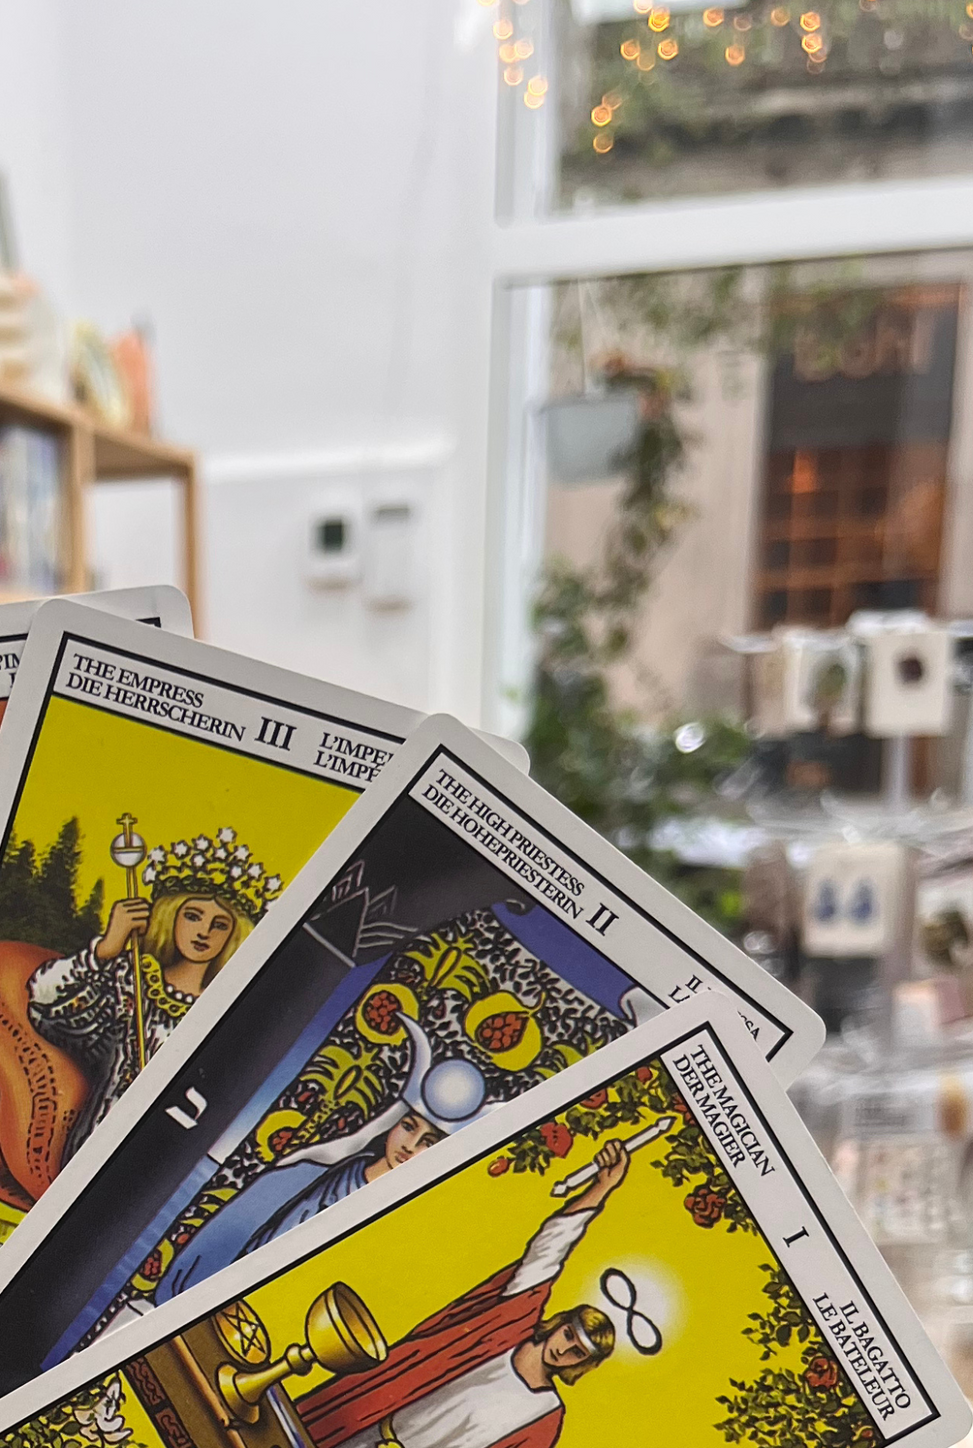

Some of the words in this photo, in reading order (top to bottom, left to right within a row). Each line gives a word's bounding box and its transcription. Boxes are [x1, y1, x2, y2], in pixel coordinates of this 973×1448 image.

[65, 672, 103, 697] DIE
[103, 684, 246, 742] HERRSCHERIN
[73, 653, 116, 681] THE
[118, 668, 205, 709] EMPRESS
[254, 716, 297, 752] III
[422, 784, 455, 815] DIE
[449, 806, 584, 920] HOHEPRIESTERIN
[436, 768, 472, 805] THE
[467, 796, 515, 836] HIGH
[508, 830, 585, 896] PRIESTESS
[585, 902, 619, 937] II
[672, 1054, 705, 1098] DER
[696, 1093, 746, 1168] MAGIER
[690, 1044, 723, 1089] THE
[713, 1084, 776, 1177] MAGICIAN
[782, 1226, 810, 1248] I
[812, 1292, 838, 1321] LE
[828, 1319, 895, 1422] BATELEUR
[839, 1300, 860, 1325] IL
[852, 1321, 911, 1409] BAGATTO
